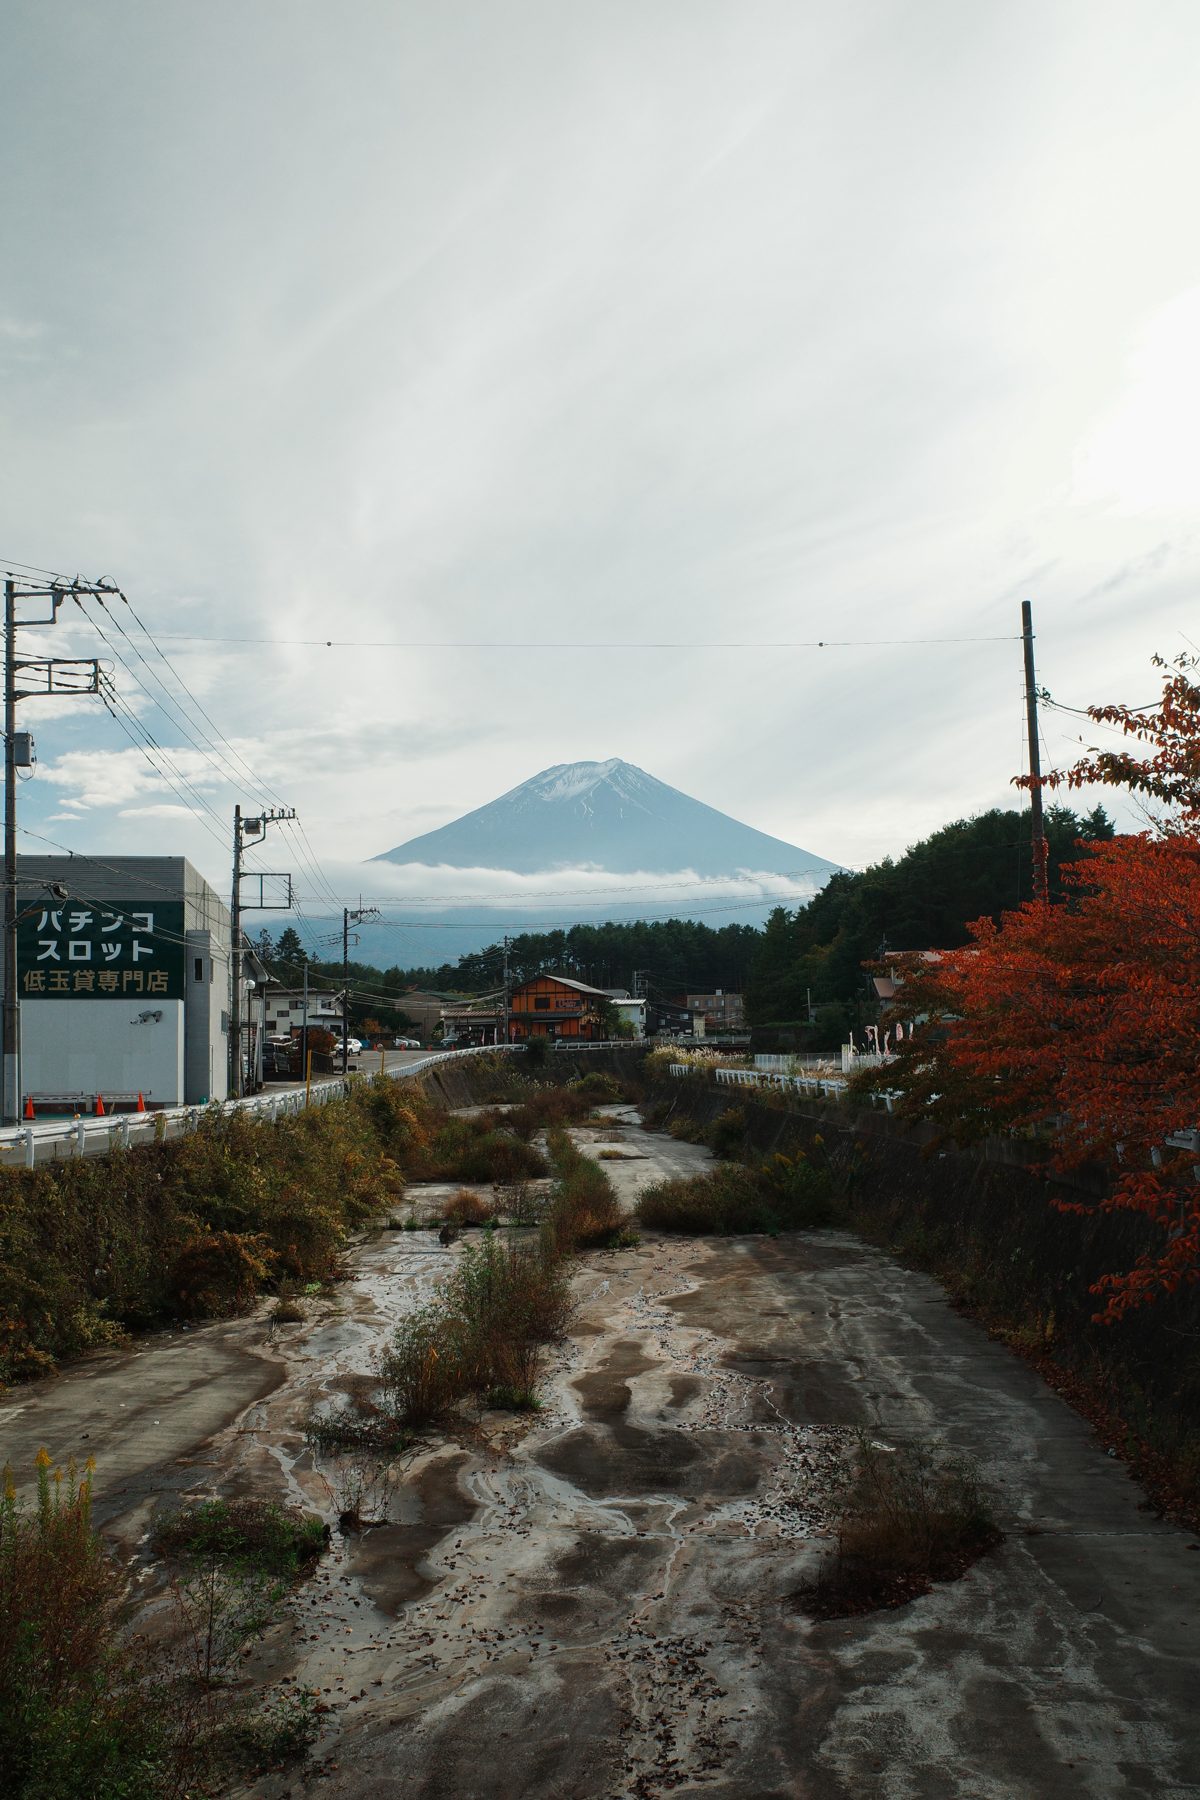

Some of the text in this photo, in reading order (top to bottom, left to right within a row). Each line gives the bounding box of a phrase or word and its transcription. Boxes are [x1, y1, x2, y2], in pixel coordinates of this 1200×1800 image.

[37, 910, 154, 933] パチンコ
[36, 940, 154, 961] スロット
[23, 969, 169, 992] 低玉貸専門店
